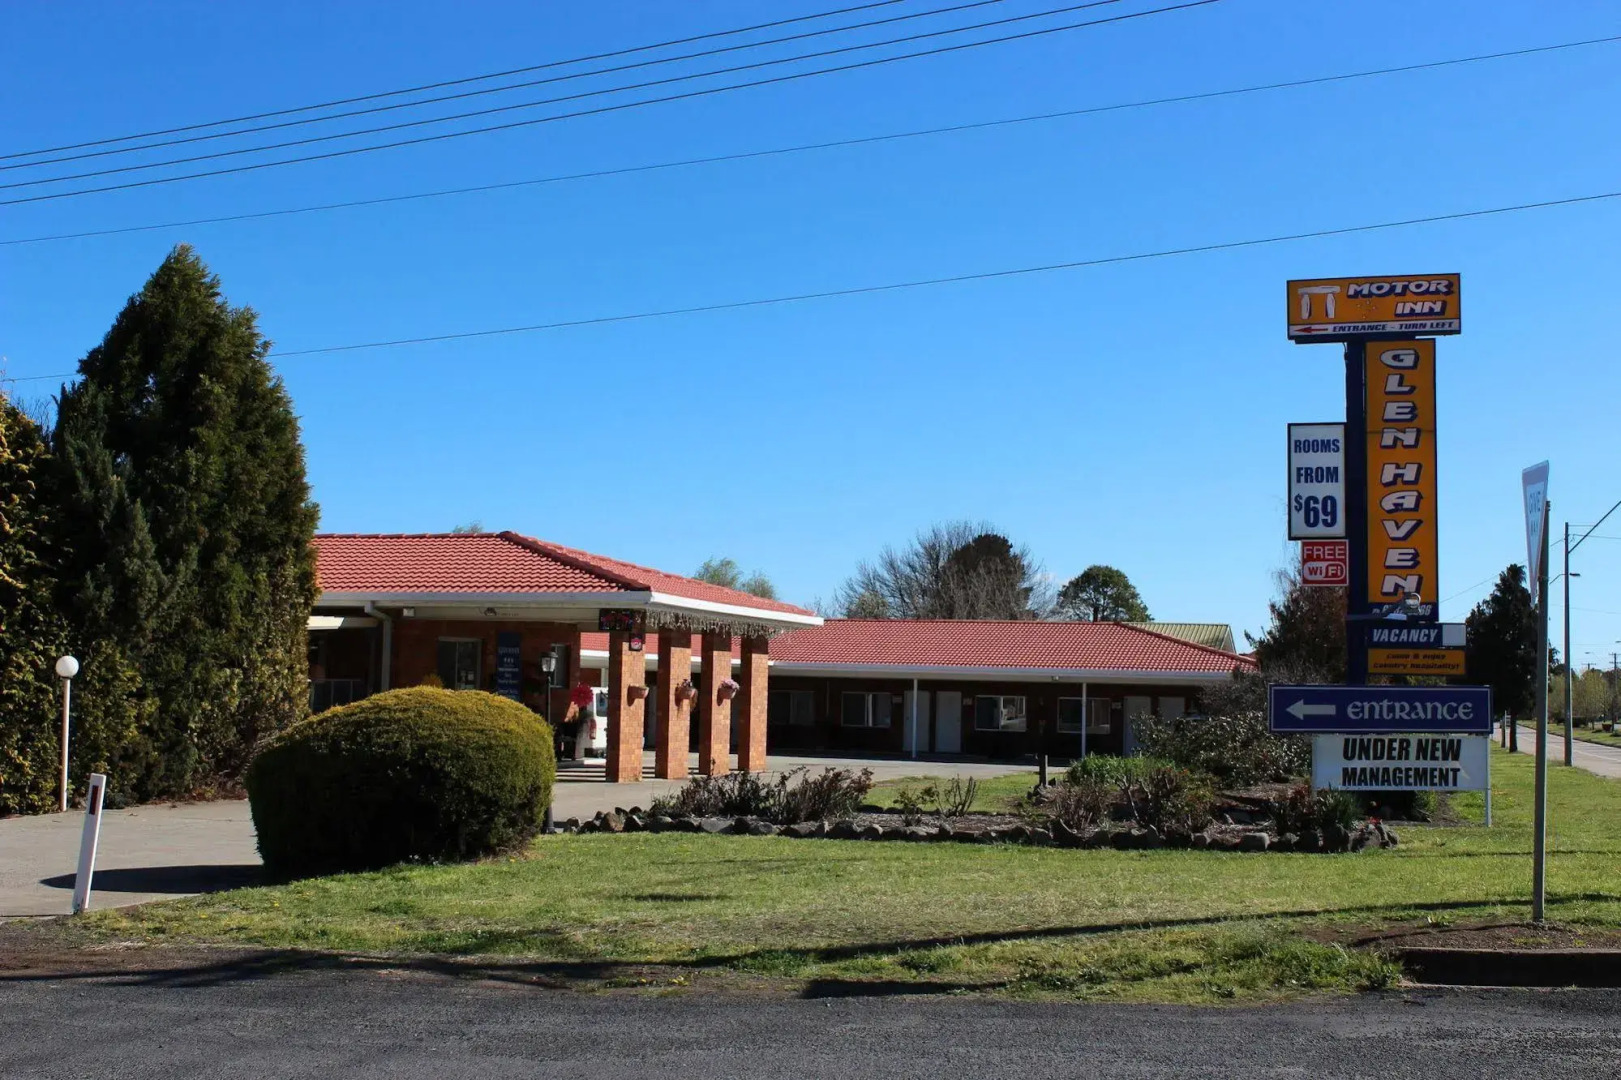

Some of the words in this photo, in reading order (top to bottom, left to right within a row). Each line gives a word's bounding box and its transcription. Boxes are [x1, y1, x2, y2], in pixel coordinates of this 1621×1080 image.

[1347, 279, 1454, 299] MOTOR
[1394, 300, 1447, 318] INN
[1332, 323, 1387, 333] ENTRANCE
[1399, 322, 1428, 331] TURN
[1430, 320, 1454, 329] LEFT
[1294, 439, 1340, 453] ROOMS
[1296, 466, 1339, 483] FROM
[1294, 493, 1337, 528] $69
[1304, 546, 1345, 559] FREE
[1372, 628, 1438, 643] VACANCY
[1342, 738, 1411, 761] UNDER
[1415, 738, 1462, 761] NEW
[1341, 767, 1461, 787] MANAGEMENT
